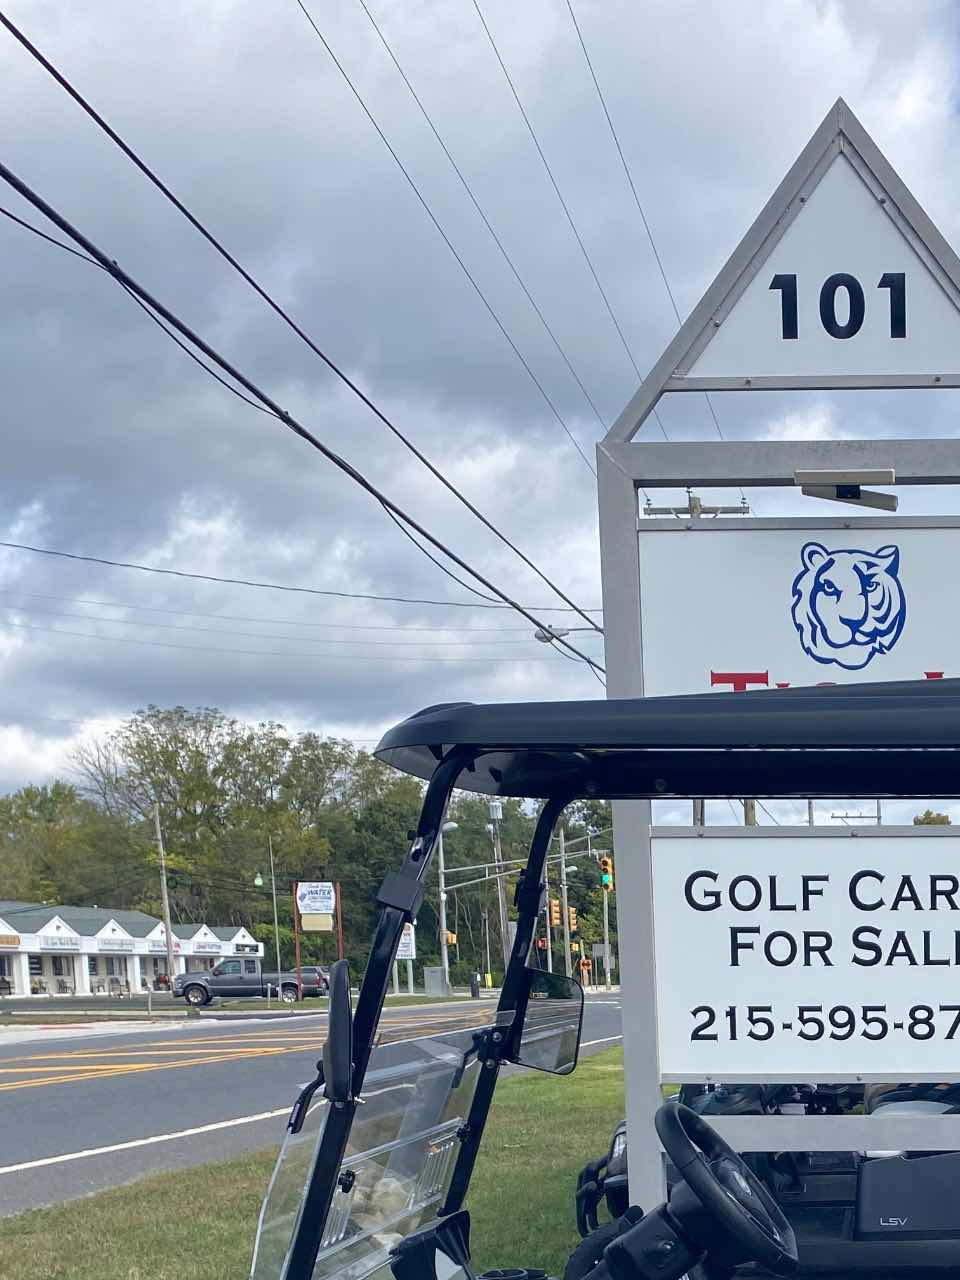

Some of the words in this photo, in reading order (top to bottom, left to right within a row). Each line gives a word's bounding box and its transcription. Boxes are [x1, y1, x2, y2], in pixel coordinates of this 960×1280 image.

[769, 272, 907, 340] 101
[684, 869, 830, 912] GOLF
[728, 925, 834, 967] FOR
[880, 1217, 908, 1226] LSV
